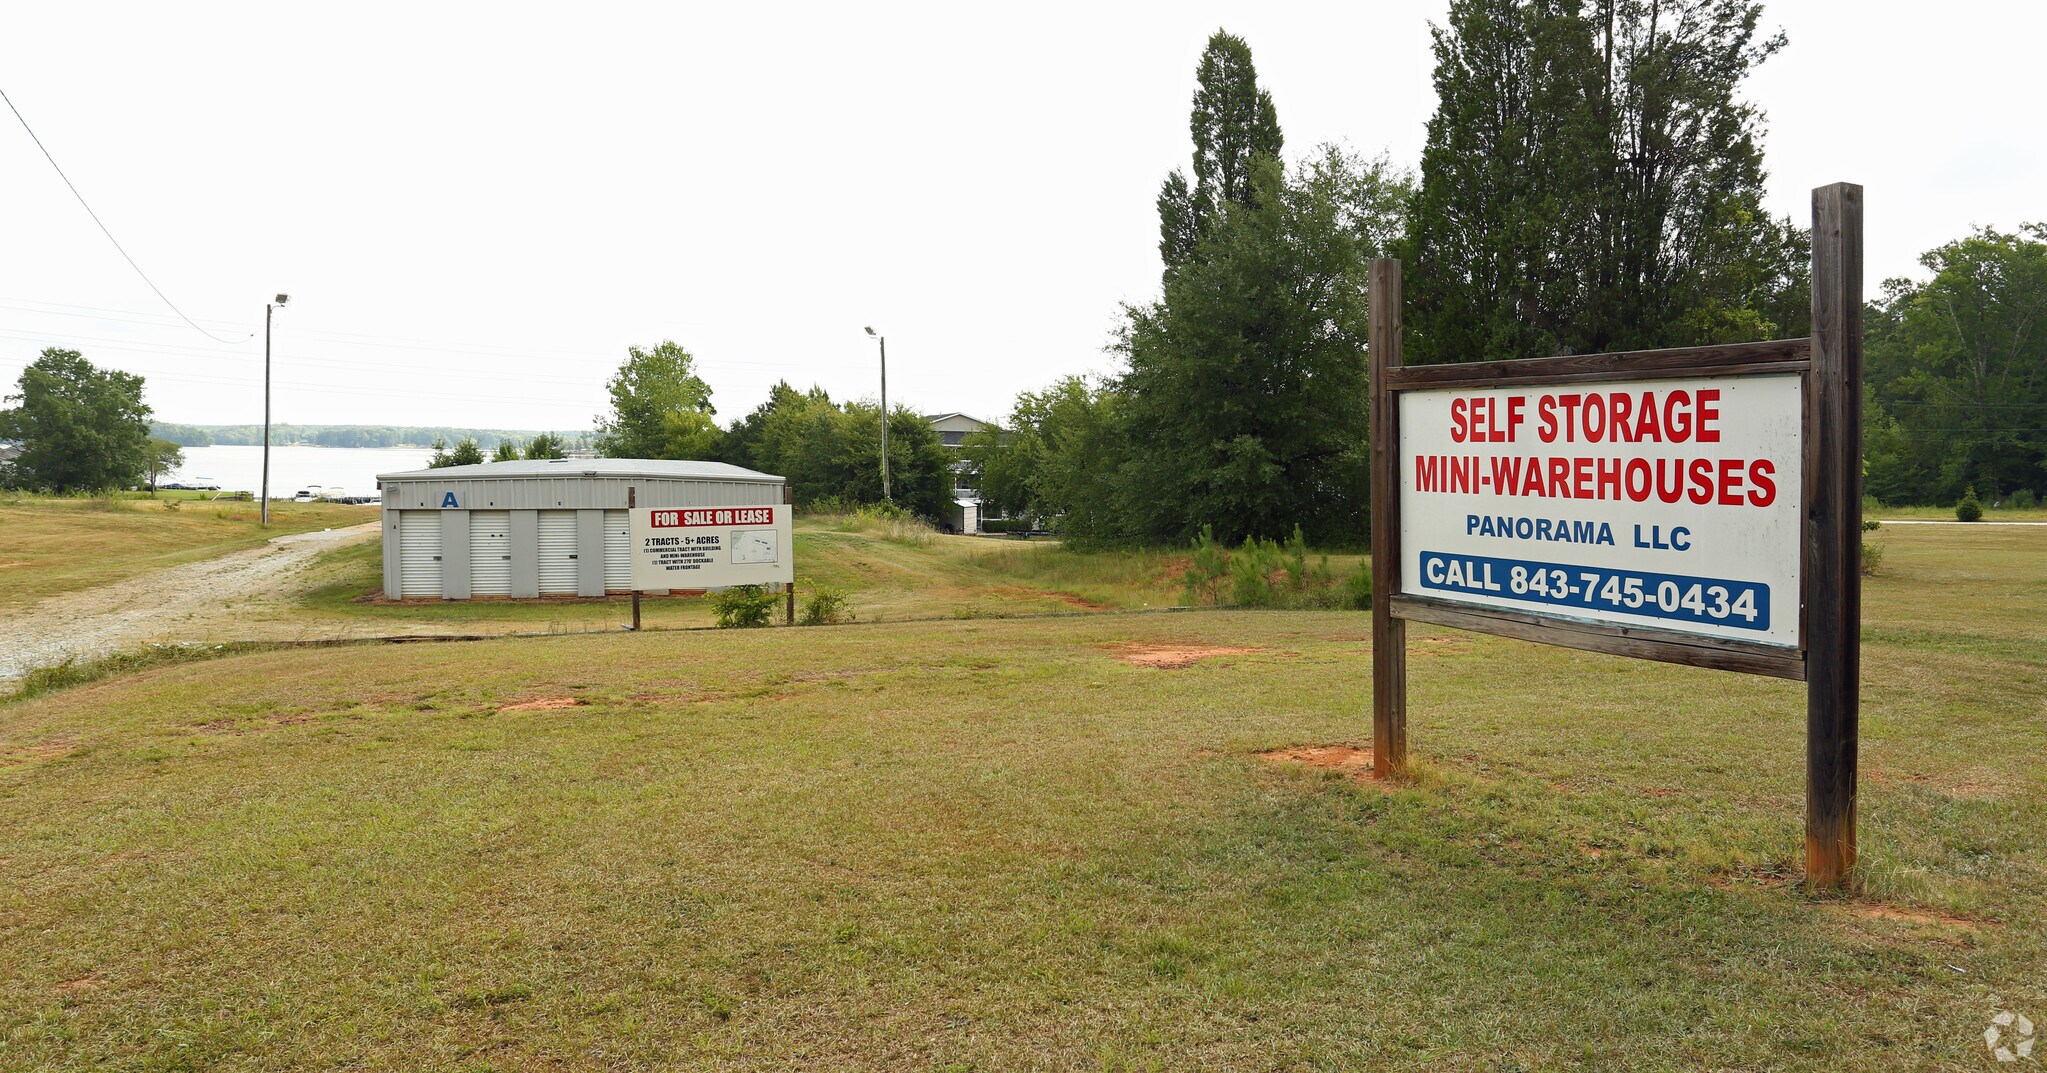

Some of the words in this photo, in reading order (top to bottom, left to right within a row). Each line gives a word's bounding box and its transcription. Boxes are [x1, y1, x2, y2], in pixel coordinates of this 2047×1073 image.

[1450, 396, 1526, 443] SELF
[1537, 389, 1721, 443] STORAGE
[441, 491, 459, 508] A
[1415, 455, 1777, 508] MINI-WAREHOUSES
[654, 512, 679, 526] FOR
[684, 511, 713, 526] SALE
[715, 510, 733, 525] OR
[735, 509, 770, 524] LEASE
[1466, 514, 1616, 546] PANORAMA
[1633, 524, 1692, 552] LLC
[645, 538, 650, 546] 2
[651, 537, 680, 546] TRACTS
[685, 536, 695, 545] 5+
[696, 536, 720, 545] ACRES
[1426, 557, 1501, 592] CALL
[1509, 565, 1758, 622] 843-745-0434
